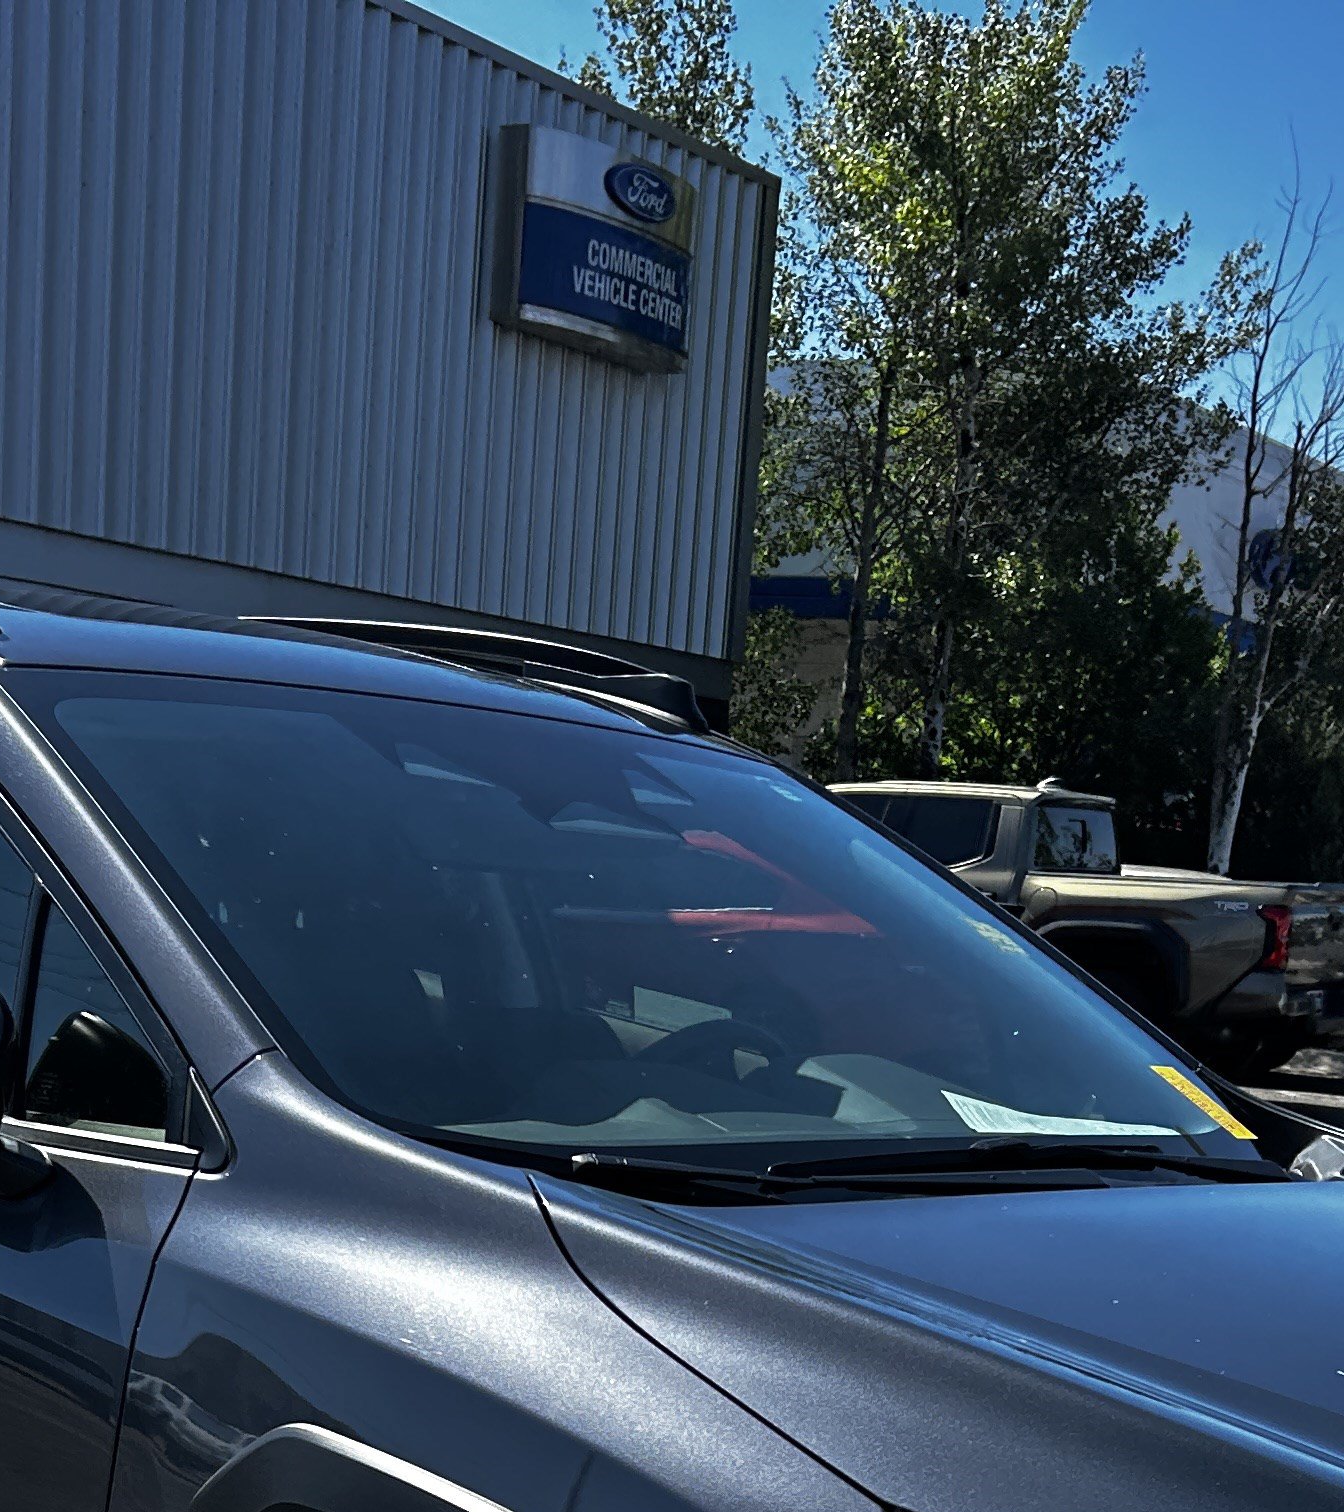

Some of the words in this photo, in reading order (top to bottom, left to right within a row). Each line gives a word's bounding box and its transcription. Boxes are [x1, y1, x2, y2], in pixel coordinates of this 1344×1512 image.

[627, 172, 666, 214] Ford
[587, 238, 677, 297] COMMERCIAL
[573, 264, 636, 311] VEHICLE
[639, 288, 683, 331] CENTER
